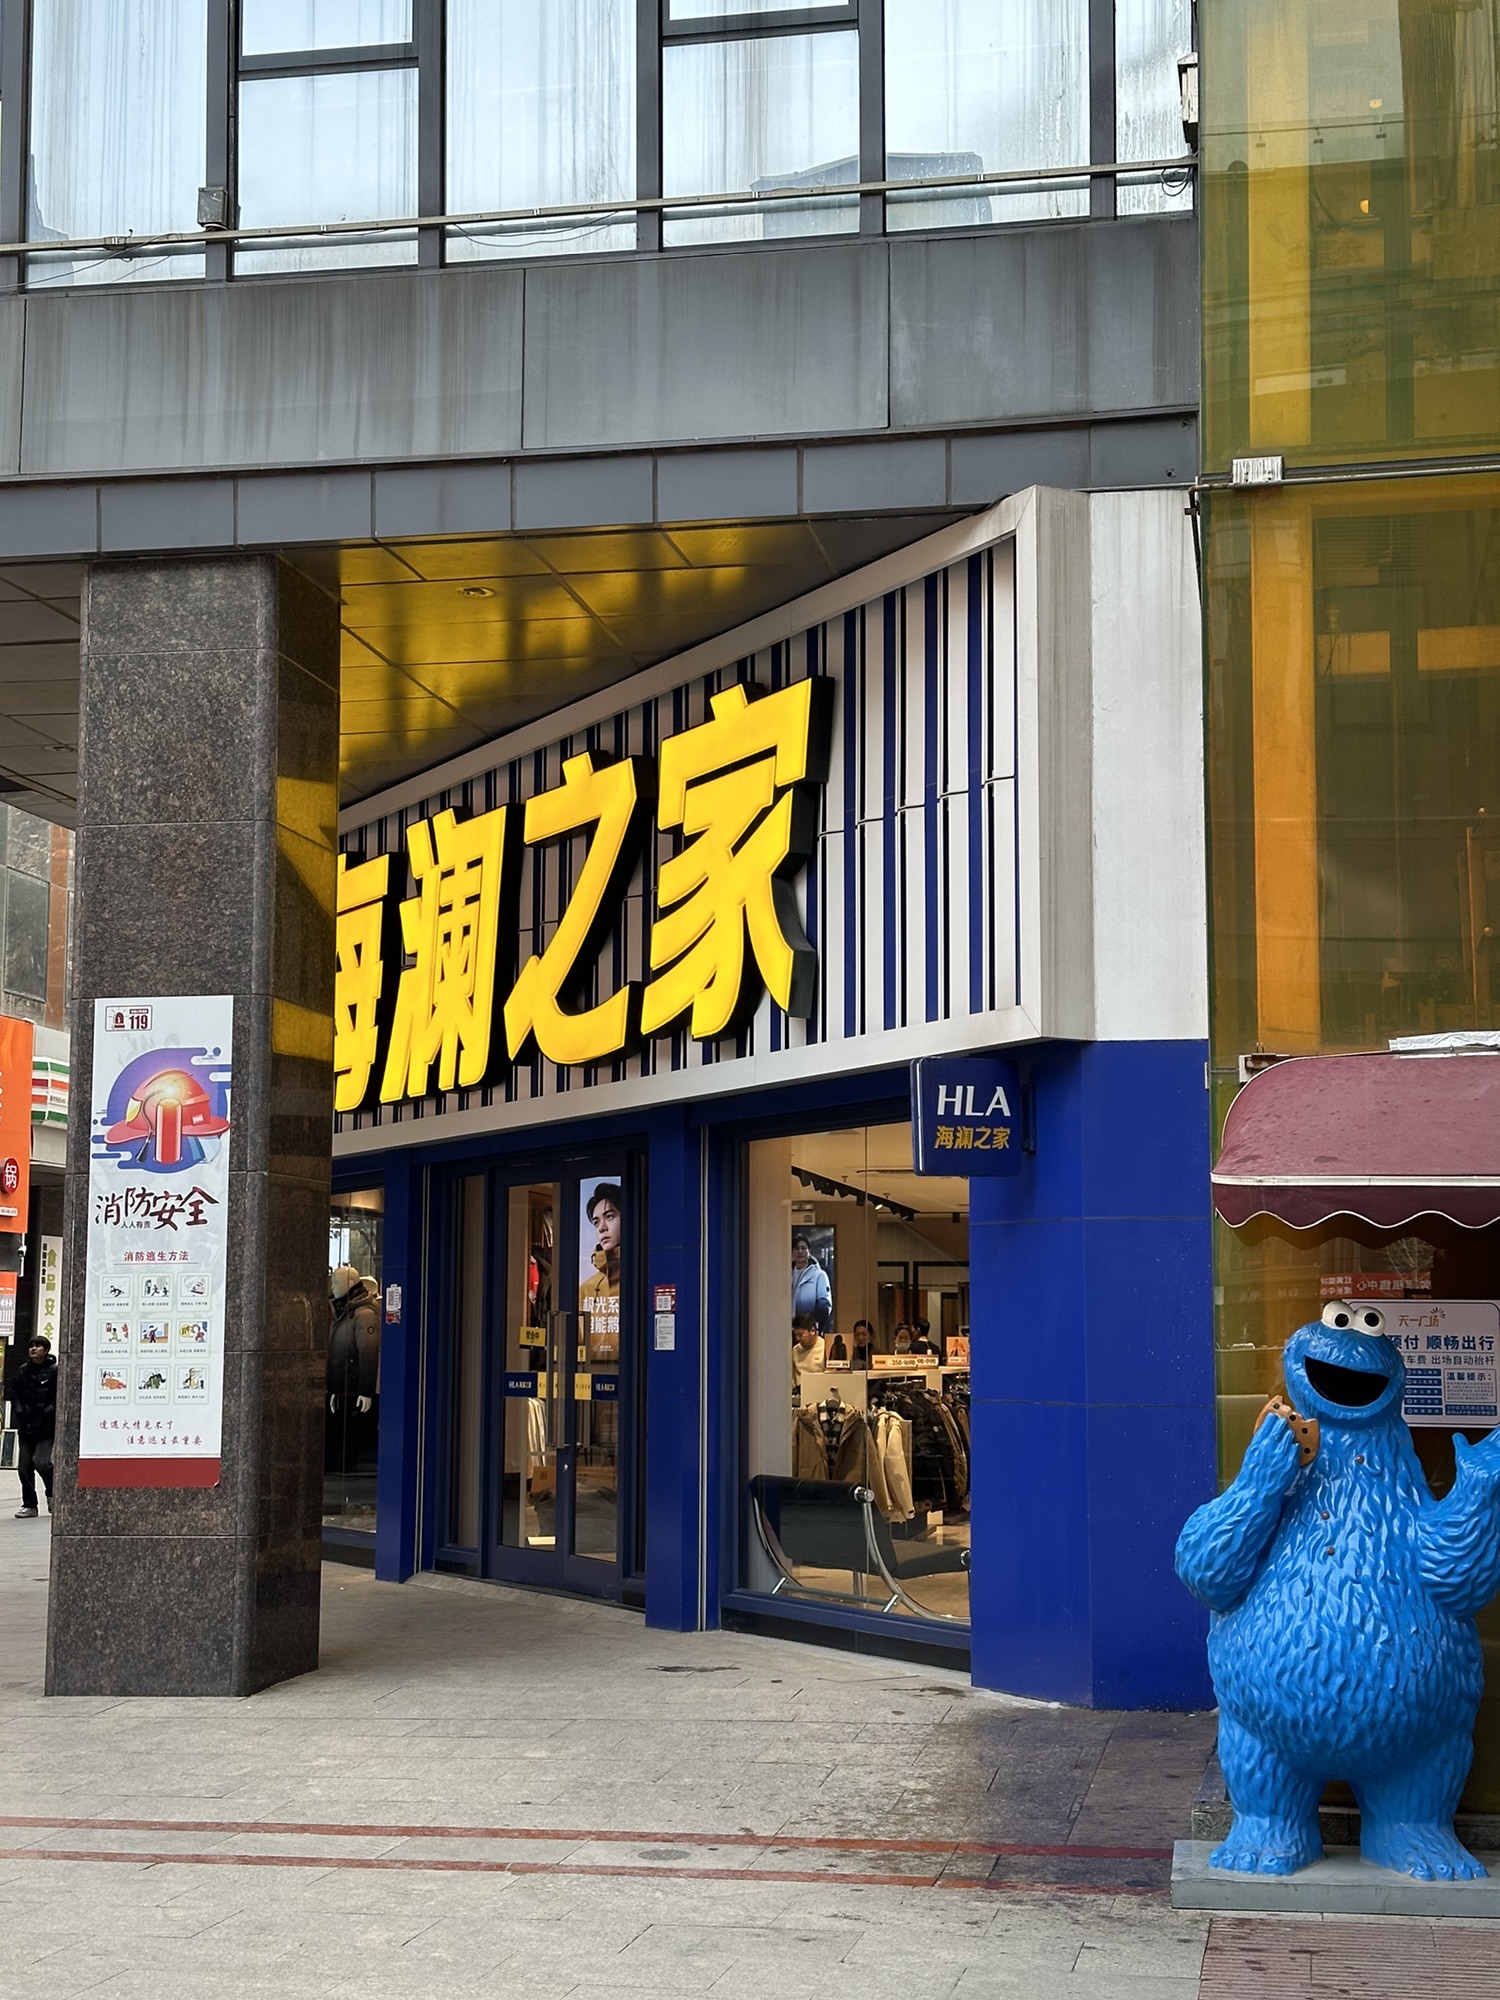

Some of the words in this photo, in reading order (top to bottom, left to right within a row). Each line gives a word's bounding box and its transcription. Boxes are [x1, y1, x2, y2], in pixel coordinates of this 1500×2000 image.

[129, 1015, 148, 1030] 119
[937, 1085, 1011, 1117] HLA
[934, 1125, 1011, 1149] 海澜之家
[5, 1163, 17, 1189] 锅
[95, 1187, 220, 1231] 消防安全
[124, 1251, 190, 1262] 消防逃生方法
[44, 1248, 58, 1340] 食品安全
[1398, 1314, 1440, 1328] 天一广场
[1426, 1334, 1495, 1351] 顺畅出行
[1403, 1355, 1427, 1365] 车费
[1431, 1355, 1495, 1366] 出场自动抬杆
